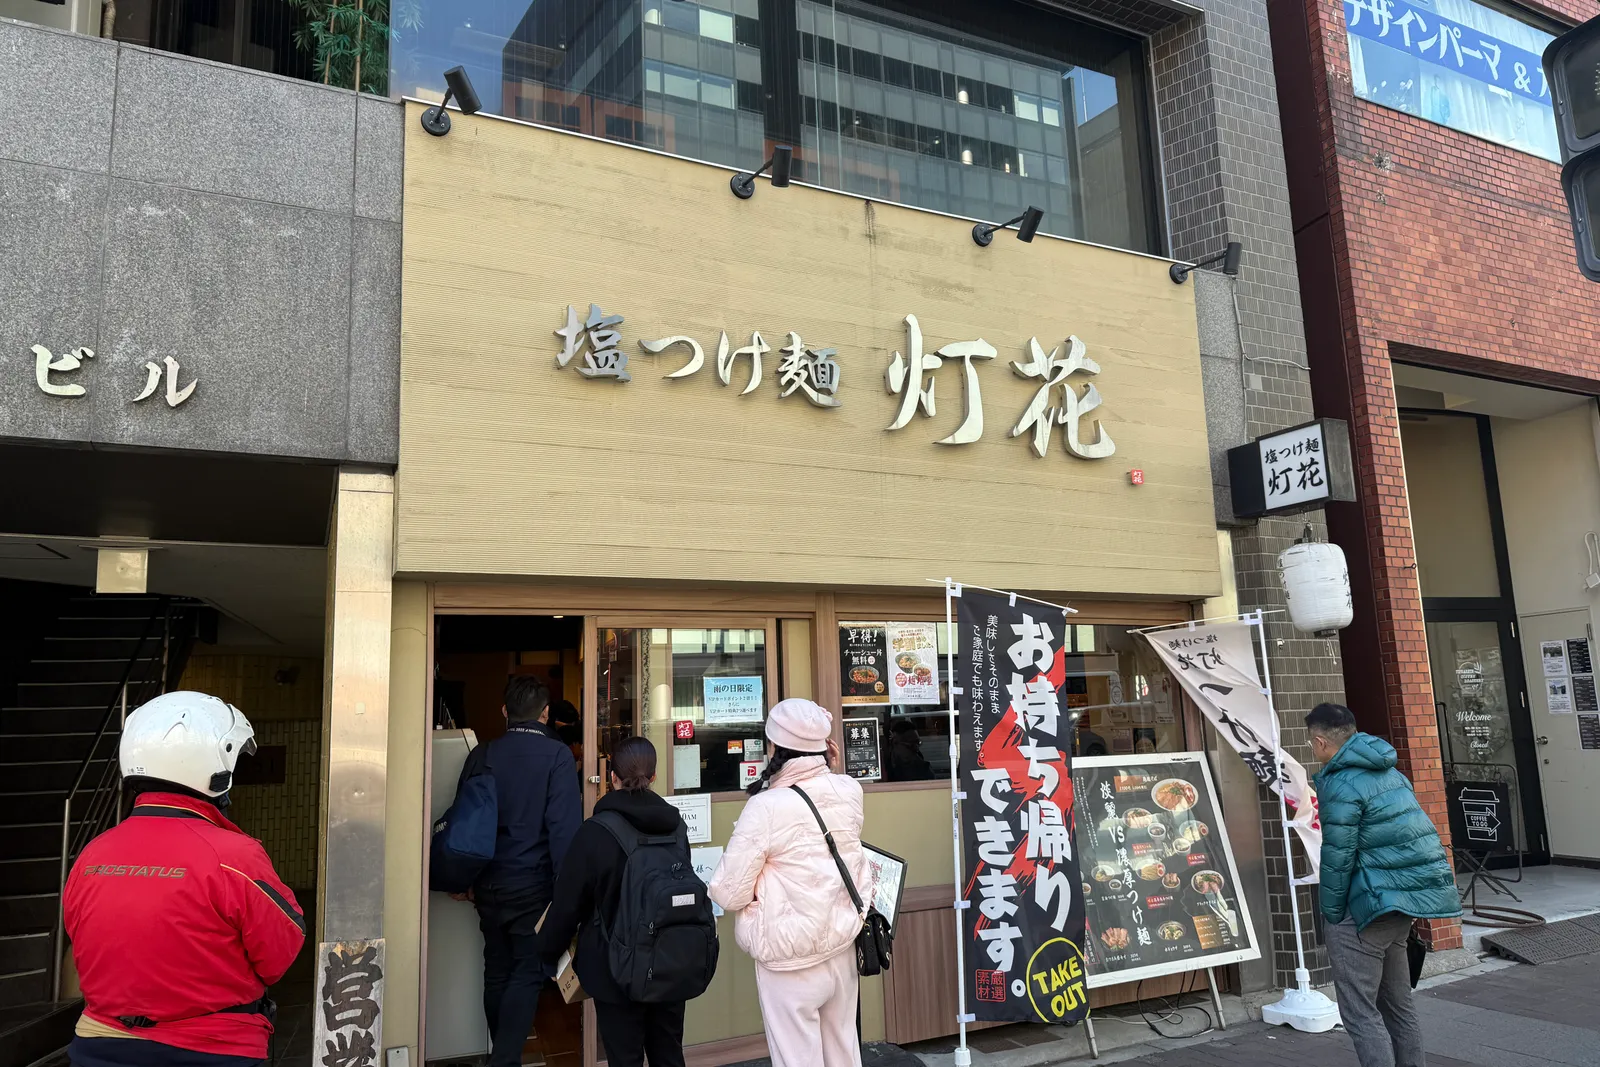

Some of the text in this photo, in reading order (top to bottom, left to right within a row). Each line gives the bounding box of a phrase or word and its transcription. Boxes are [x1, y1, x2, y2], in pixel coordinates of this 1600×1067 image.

[1513, 61, 1532, 93] &
[30, 343, 199, 408] ビル
[553, 303, 1116, 460] 塩つけ麺 灯花
[1264, 437, 1320, 465] 塩つけ麺
[1133, 470, 1143, 483] 灯花
[1268, 457, 1325, 496] 灯花
[852, 656, 867, 665] 無料
[985, 614, 1001, 714] 美味しさそのまま
[713, 684, 753, 693] 雨の日限定
[971, 624, 985, 759] ご家庭でも味わえます。
[678, 722, 692, 737] 灯花
[1456, 711, 1492, 722] Welcome
[1005, 613, 1073, 933] お持ち帰り
[83, 864, 187, 880] PROSTATUS
[1032, 955, 1083, 995] TAKE
[1051, 981, 1087, 1018] OUT
